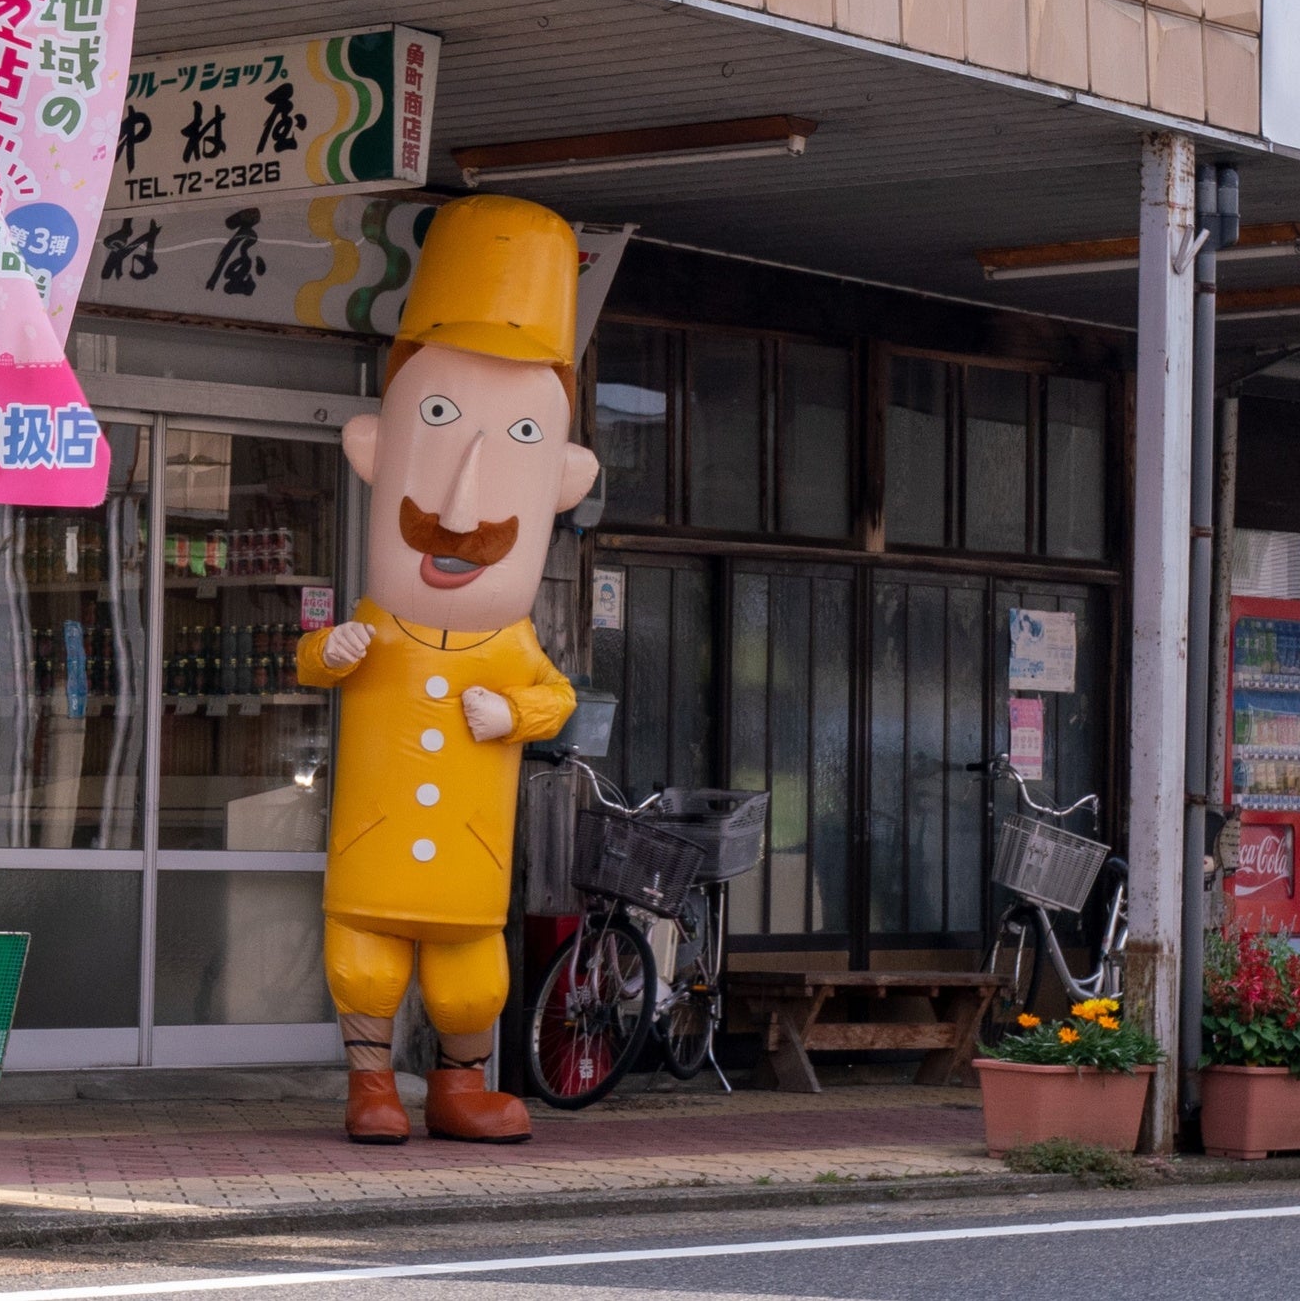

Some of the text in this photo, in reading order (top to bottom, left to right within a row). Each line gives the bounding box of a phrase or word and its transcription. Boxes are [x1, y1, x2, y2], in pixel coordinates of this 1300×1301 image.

[116, 83, 308, 174] 中村屋
[125, 160, 281, 201] TEL.72-2326
